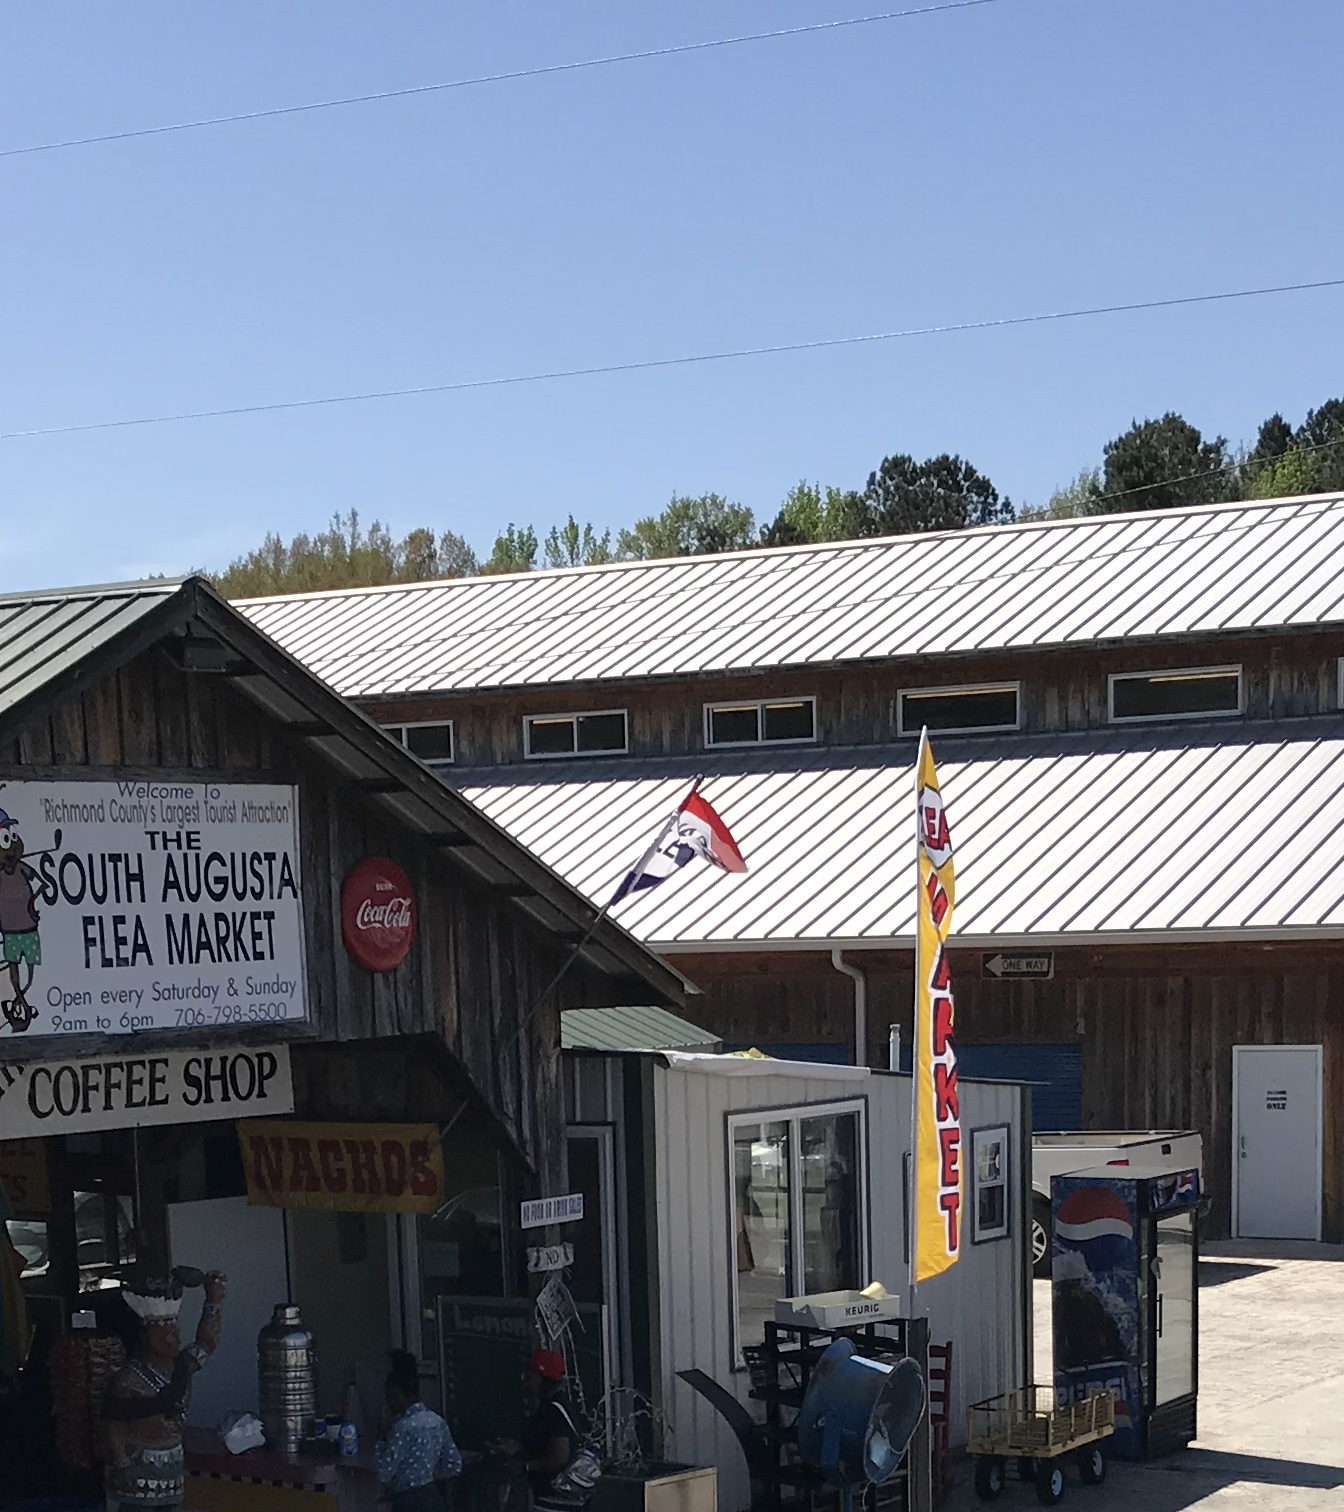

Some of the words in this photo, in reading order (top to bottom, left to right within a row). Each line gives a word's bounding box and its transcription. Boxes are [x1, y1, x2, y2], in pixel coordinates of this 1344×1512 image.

[117, 782, 194, 800] Welcome
[109, 799, 156, 829] County's
[160, 800, 200, 829] Largest
[204, 801, 237, 824] Tourist
[145, 831, 202, 851] THE
[40, 852, 146, 906] SOUTH
[162, 851, 298, 903] AUGUSTA
[81, 914, 154, 969] FLEA
[165, 910, 276, 966] MARKET
[1002, 960, 1022, 971] ONE
[1026, 960, 1045, 971] WAY
[47, 985, 92, 1013] Open
[101, 989, 145, 1009] every
[152, 977, 221, 1004] Saturday
[227, 978, 239, 997] &
[245, 973, 297, 999] Sunday
[51, 1014, 88, 1032] 9am
[97, 1014, 111, 1029] to
[119, 1012, 154, 1032] 6pm
[175, 1002, 288, 1027] 706-798-5500
[28, 1058, 170, 1119] COFFEE
[182, 1051, 278, 1106] SHOP
[248, 1135, 439, 1197] NACHOS
[845, 1303, 880, 1317] KEURIG
